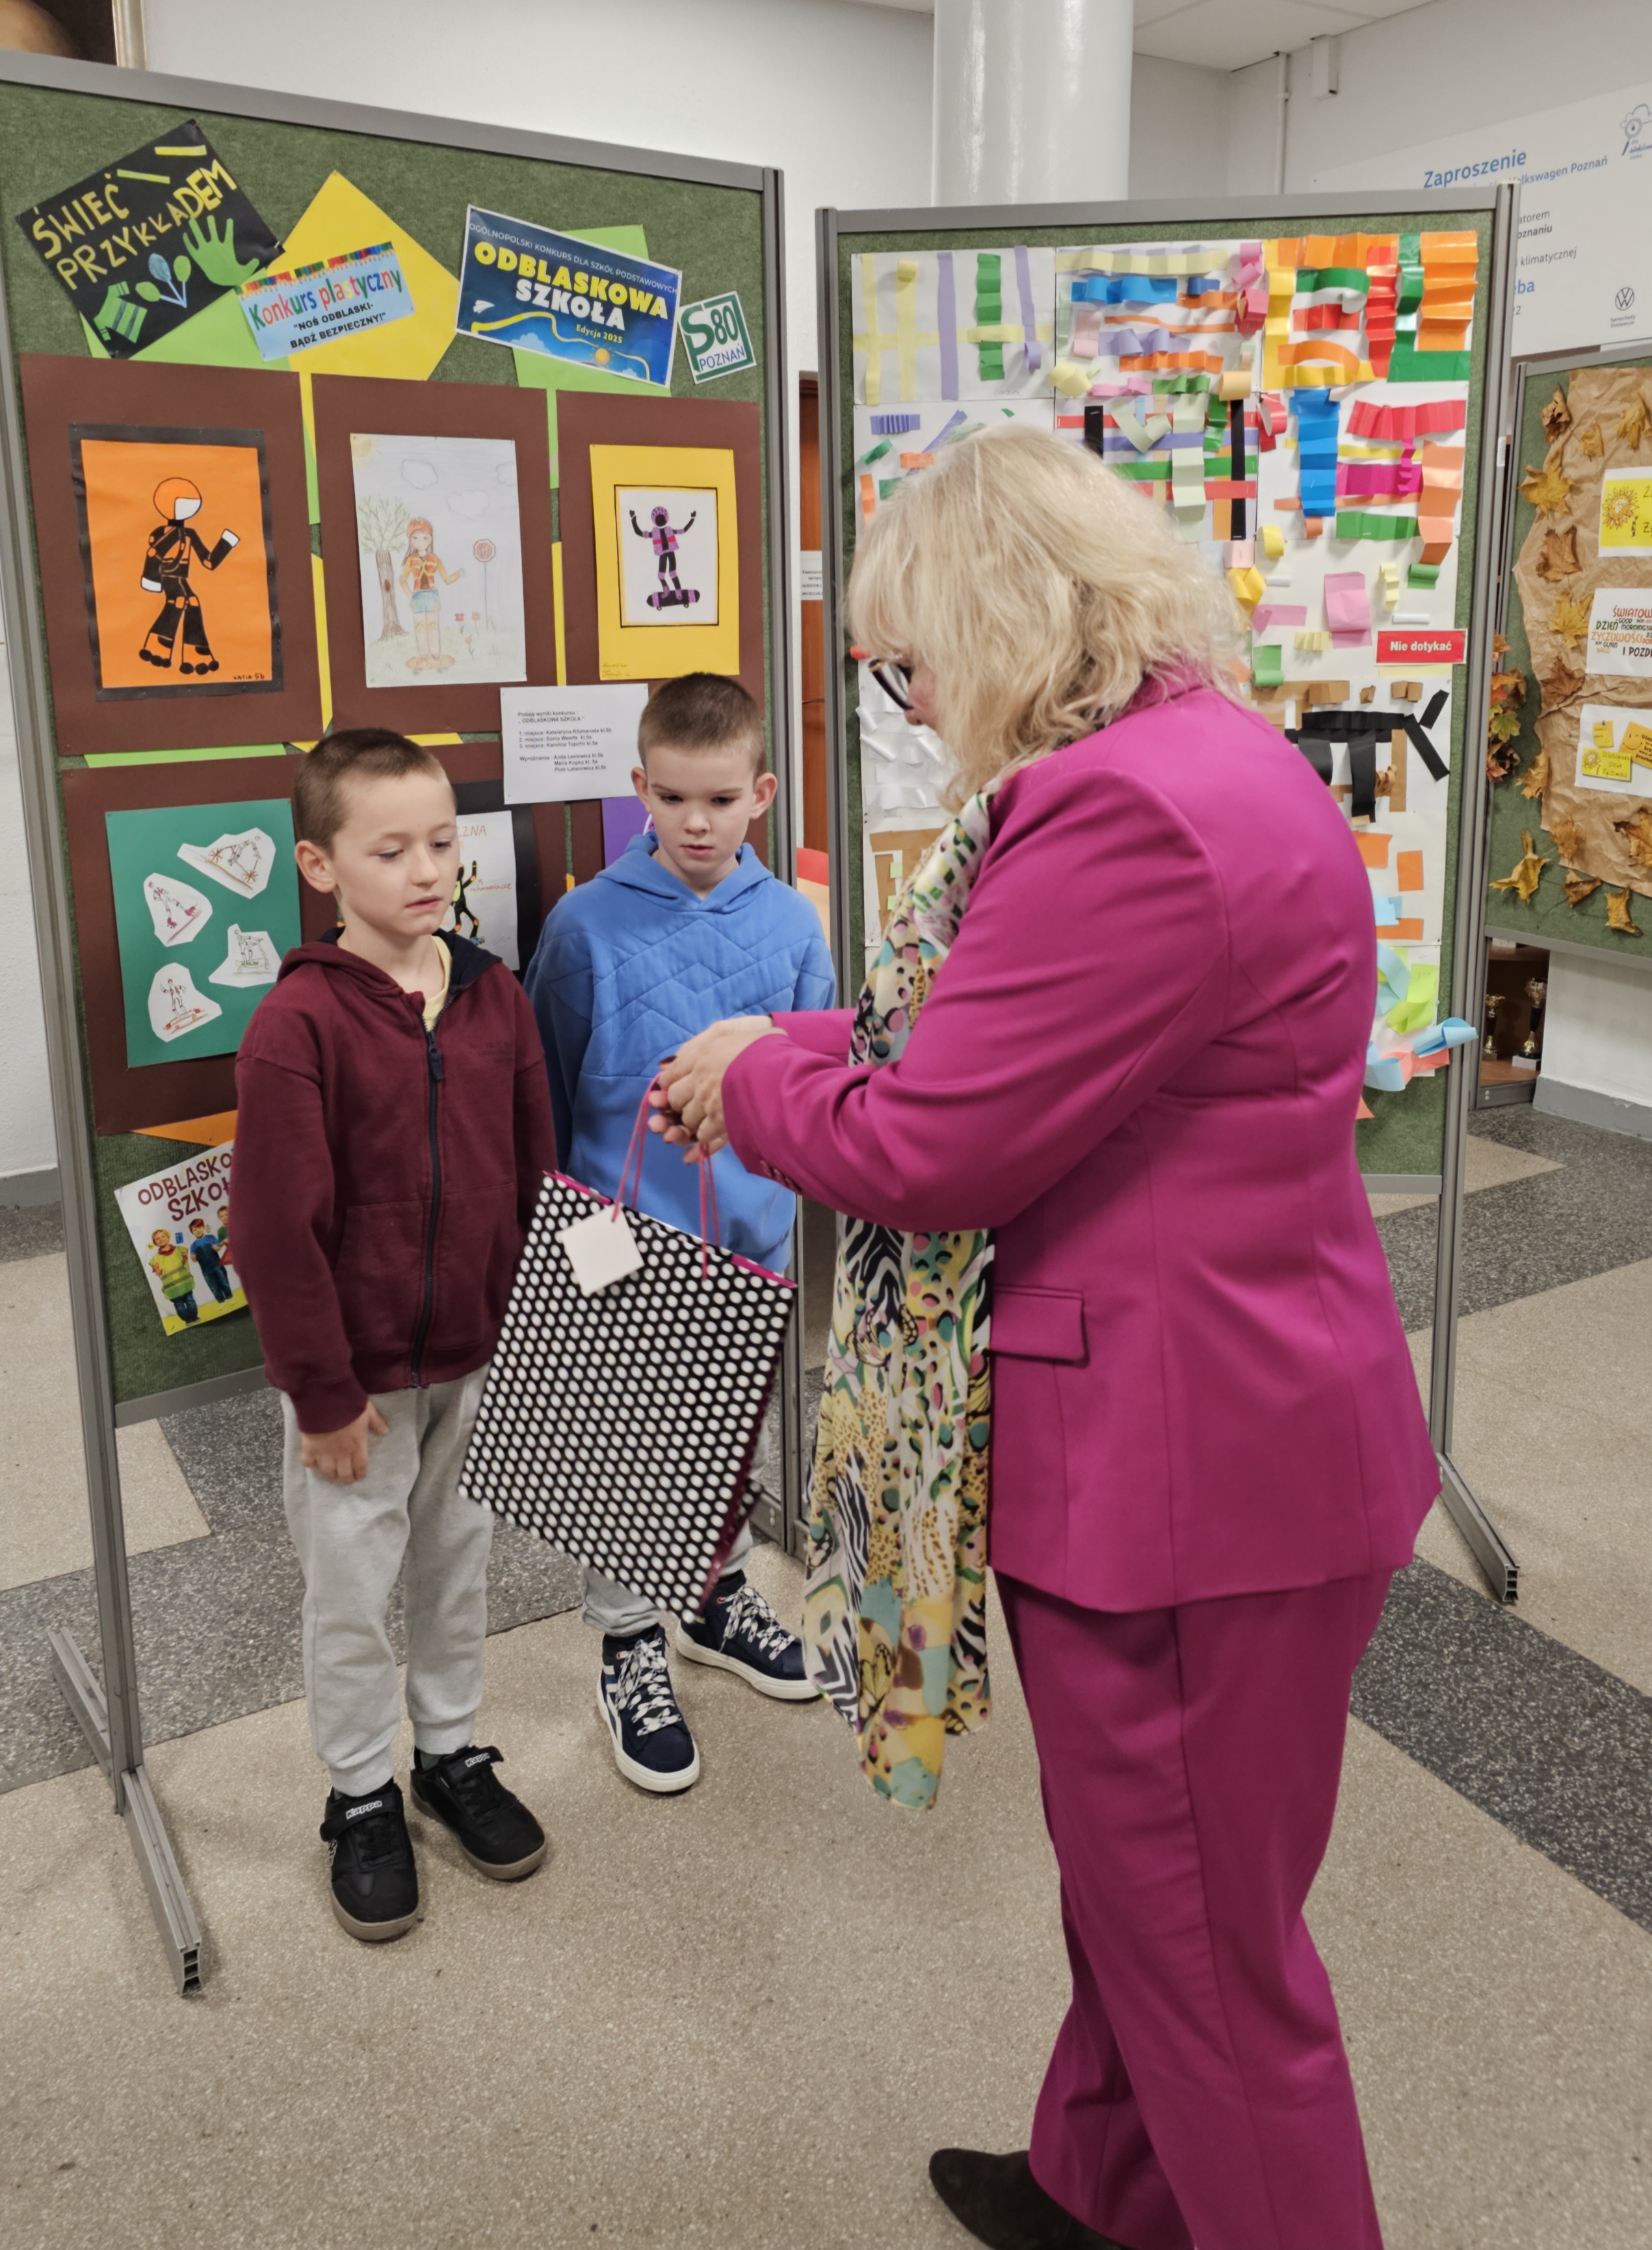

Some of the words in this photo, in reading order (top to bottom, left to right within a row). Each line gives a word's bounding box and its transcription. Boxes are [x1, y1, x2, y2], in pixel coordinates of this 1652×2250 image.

[1424, 149, 1527, 189] Zaproszenie
[1571, 155, 1608, 174] Poznań
[33, 172, 129, 259] ŚWIEĆ
[1519, 211, 1550, 224] atorem
[1517, 224, 1553, 239] oznaniu
[469, 222, 533, 248] OGÓLNOPOLSKI
[534, 244, 572, 261] KONKURS
[573, 256, 589, 267] DLA
[590, 260, 614, 274] SZKÓŁ
[616, 268, 678, 295] PODSTAWOWYCH
[1521, 246, 1577, 266] klimatycznej
[474, 241, 668, 319] ODBLASKOWA
[1515, 279, 1535, 295] ba
[249, 291, 317, 331] Konkurs
[319, 270, 402, 311] plastyczny
[515, 280, 625, 330] SZKOŁA
[293, 316, 319, 330] "NOŚ
[321, 302, 374, 323] ODBLASKI-
[290, 332, 318, 348] BĄDŹ
[319, 312, 386, 339] BEZPIECZNY!"
[576, 324, 602, 339] Edycja
[603, 332, 623, 344] 2025
[699, 343, 746, 371] POZNAŃ
[1596, 618, 1618, 631] DZIEŃ
[1390, 641, 1408, 651] Nie
[1410, 641, 1452, 653] dotykać
[458, 825, 487, 838] CZNA
[138, 1148, 233, 1205] ODBLASKO
[168, 1177, 229, 1221] SZKOŁ
[465, 1752, 490, 1767] Kappa
[346, 1800, 382, 1820] Kappa
